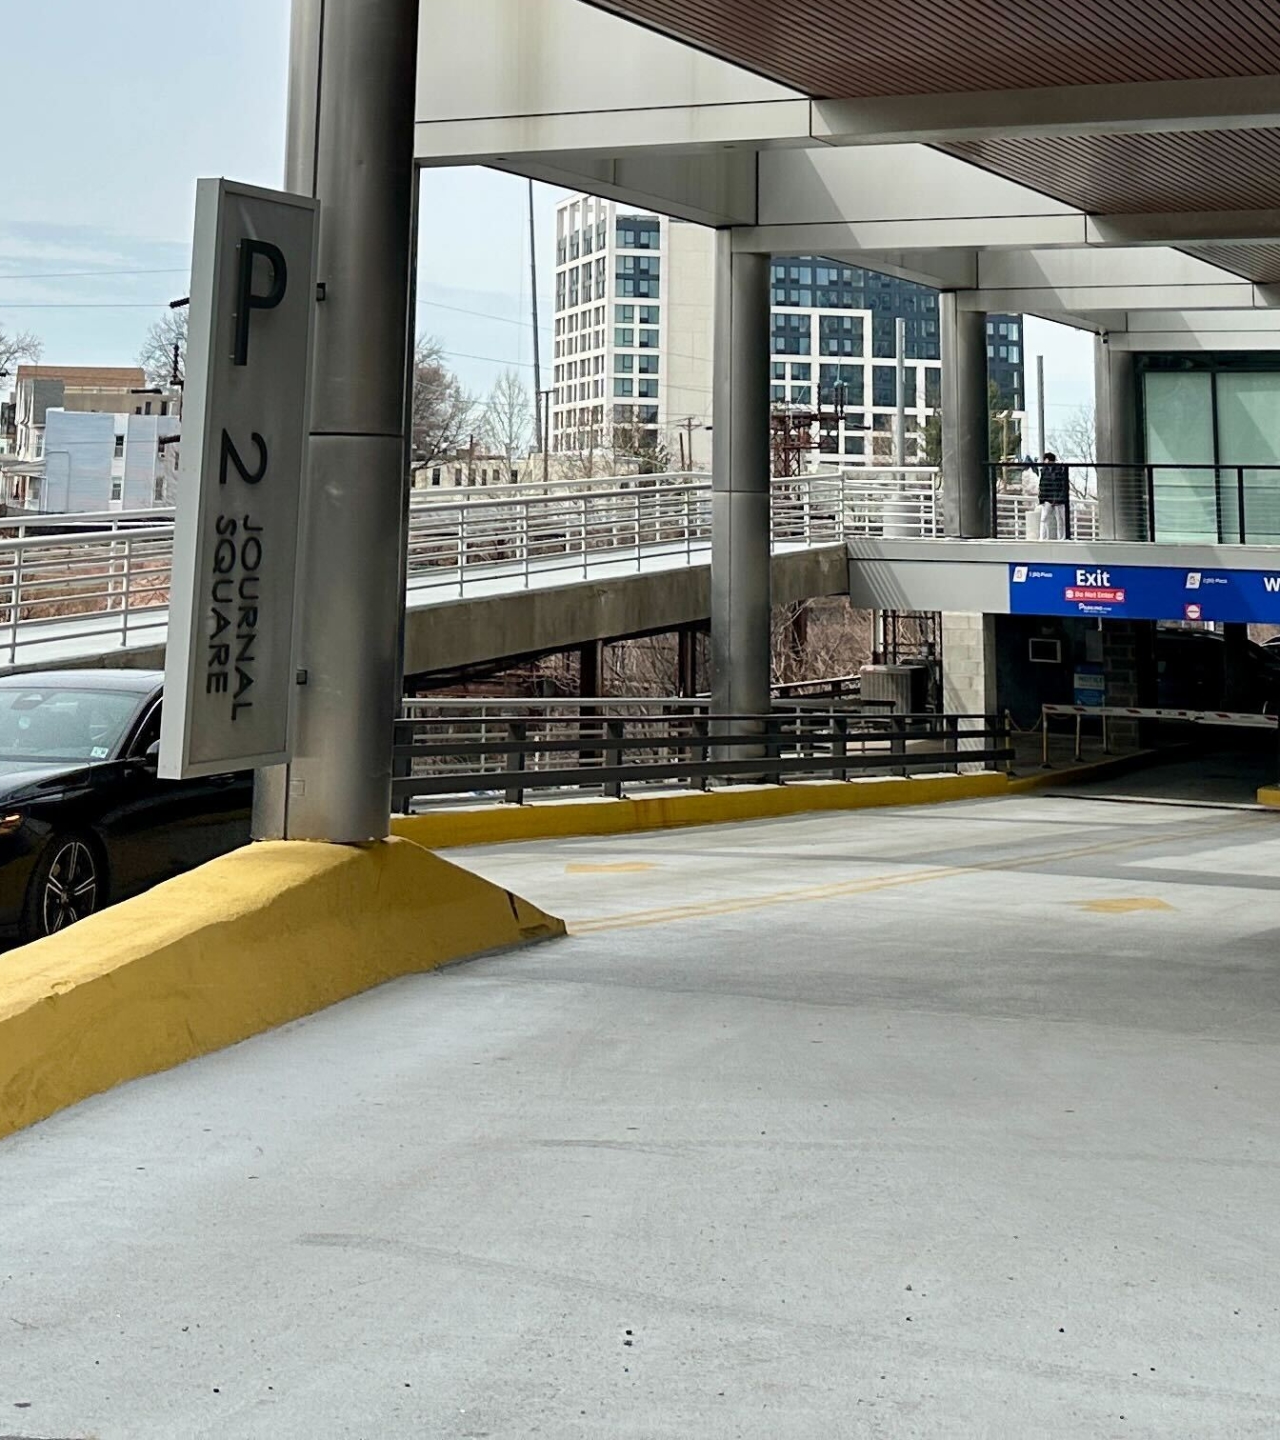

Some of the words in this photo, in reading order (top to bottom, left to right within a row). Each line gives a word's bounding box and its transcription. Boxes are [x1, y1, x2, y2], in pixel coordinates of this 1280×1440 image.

[233, 236, 289, 367] P
[219, 427, 269, 486] 2
[206, 513, 237, 696] SQUARE
[231, 513, 264, 723] JOURNAL
[1075, 569, 1111, 588] Exit
